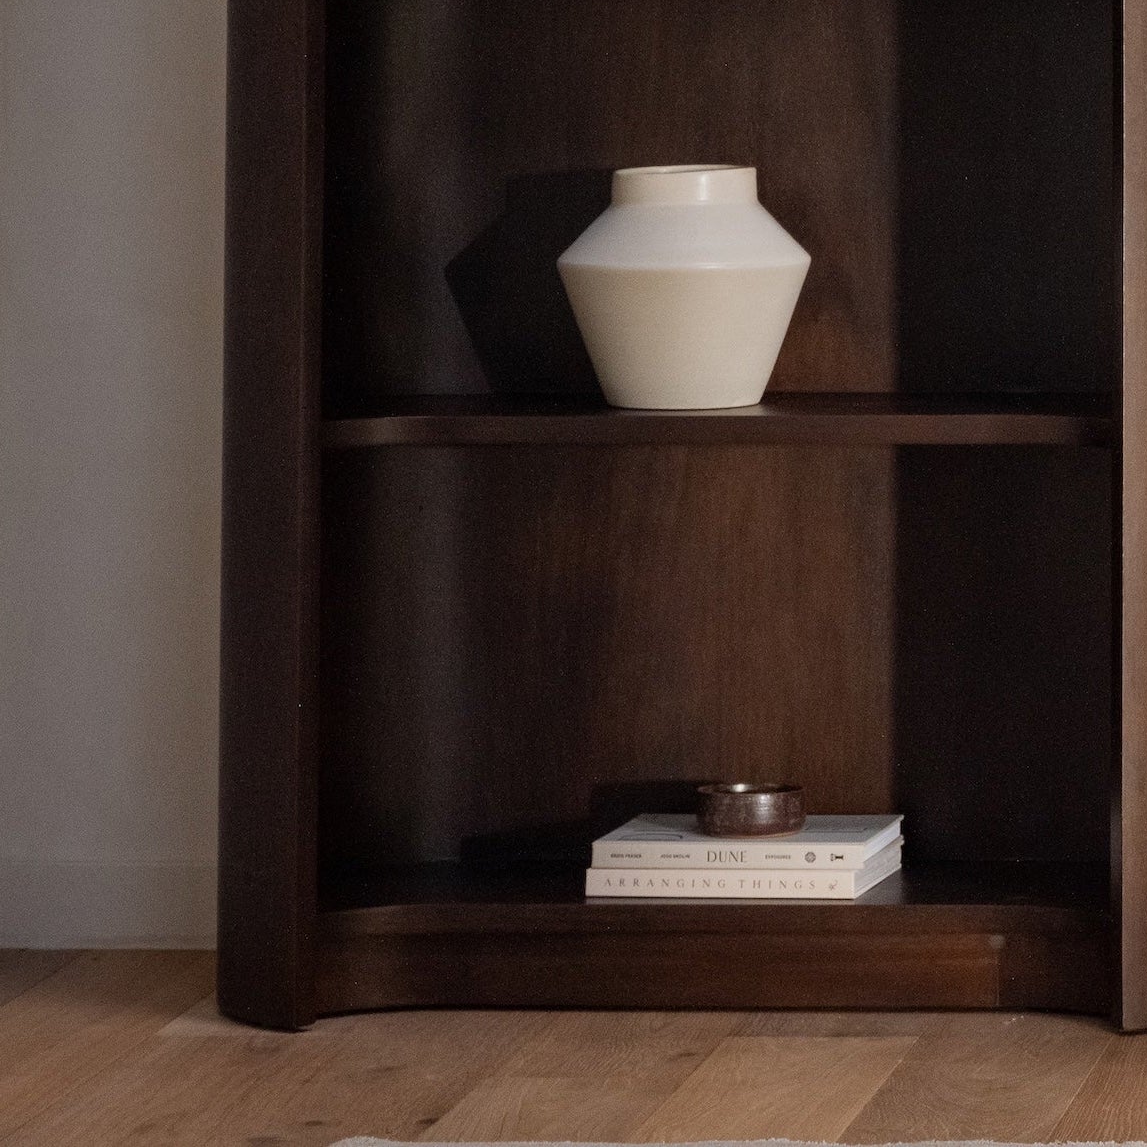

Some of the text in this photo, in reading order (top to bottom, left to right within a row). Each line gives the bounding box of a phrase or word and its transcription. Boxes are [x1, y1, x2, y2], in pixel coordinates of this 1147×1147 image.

[706, 850, 747, 863] DUNE
[603, 878, 817, 890] ARRANGING THINGS
